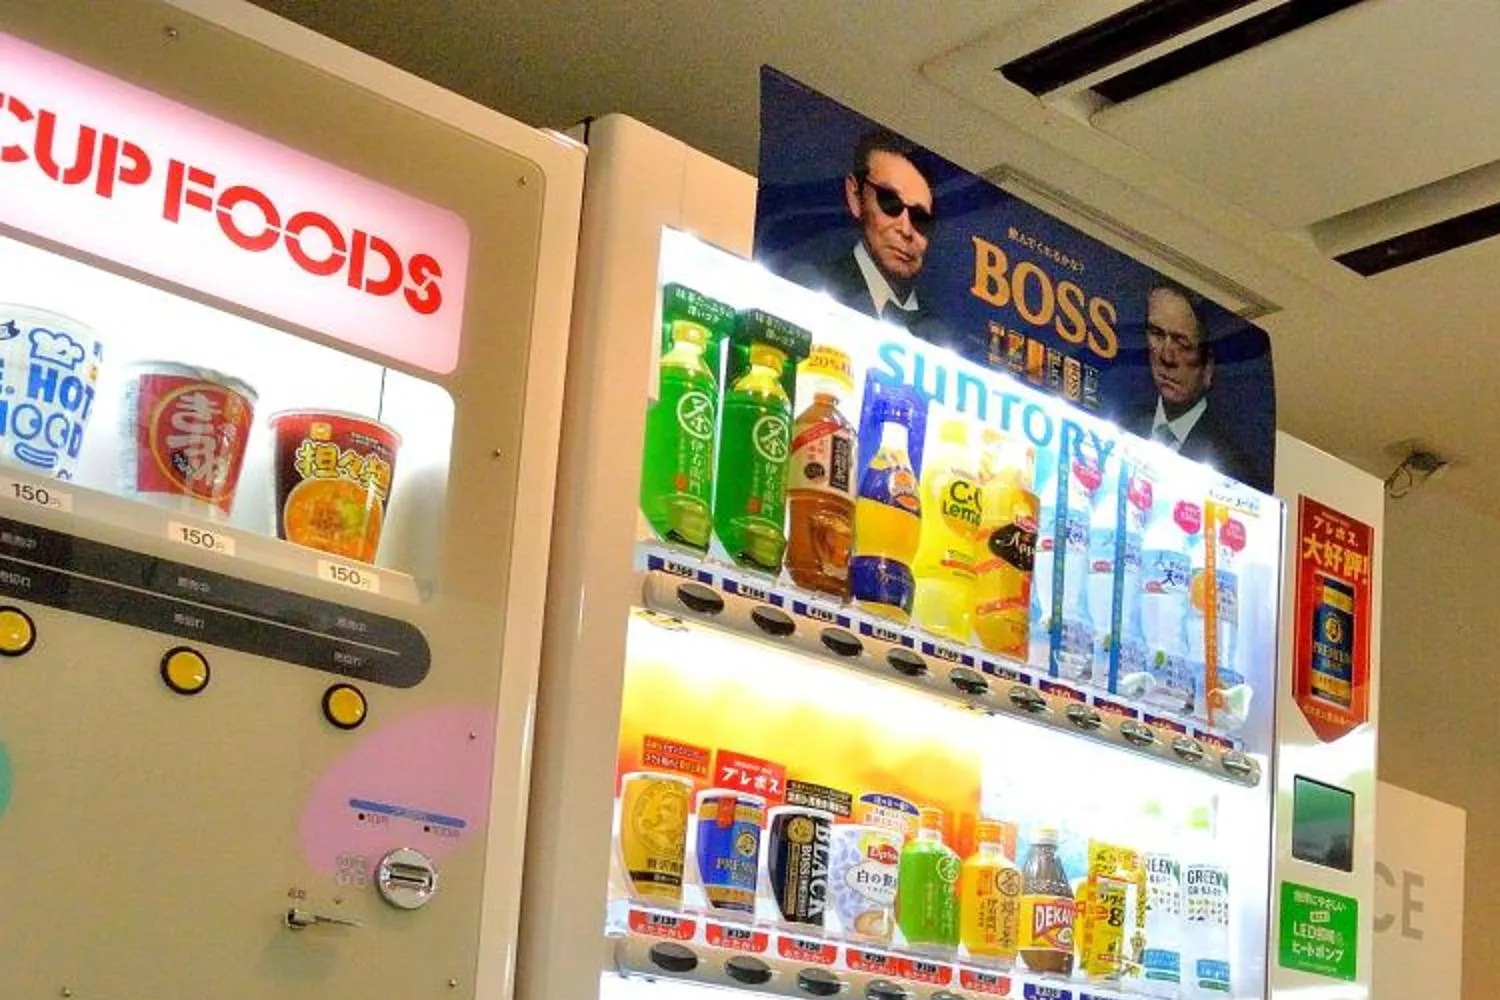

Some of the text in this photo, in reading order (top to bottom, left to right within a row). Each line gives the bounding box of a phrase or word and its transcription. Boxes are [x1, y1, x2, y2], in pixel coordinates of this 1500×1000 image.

[0, 93, 442, 315] CUP FOODS
[971, 235, 1119, 359] BOSS
[27, 363, 95, 420] HOT
[722, 767, 780, 793] プレボス
[808, 819, 832, 918] BLACK
